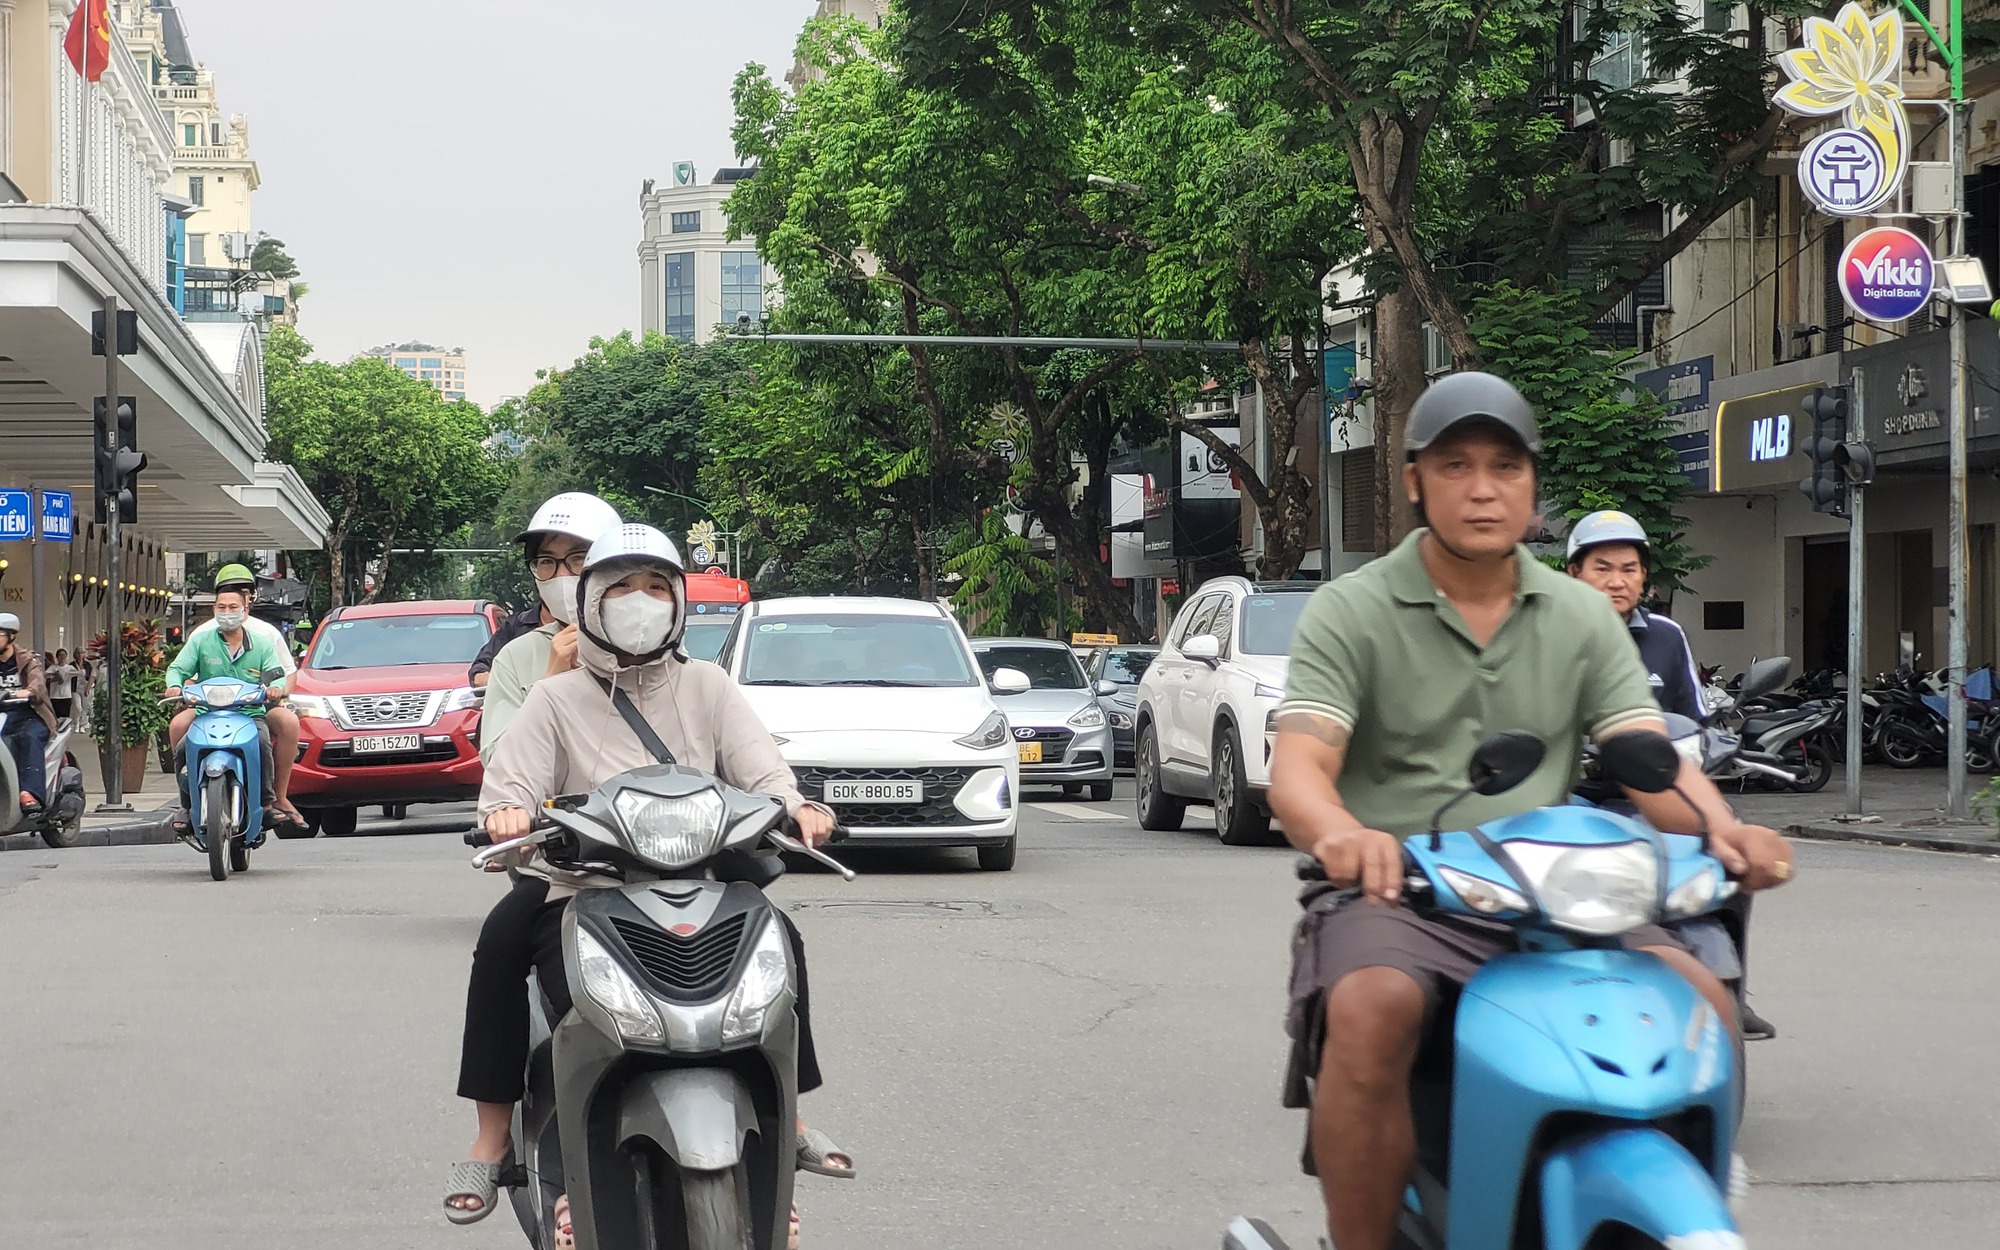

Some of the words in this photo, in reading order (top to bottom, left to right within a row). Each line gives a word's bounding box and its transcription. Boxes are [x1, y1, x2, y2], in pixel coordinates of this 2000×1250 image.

[1851, 245, 1922, 285] Vikki
[1751, 414, 1790, 461] MLB
[52, 496, 64, 508] PHỐ
[59, 513, 70, 533] BÀI
[355, 735, 418, 751] 30G-152.70
[1019, 744, 1031, 752] 8E
[1019, 753, 1038, 761] 1.12
[832, 785, 914, 798] 60K-880.85
